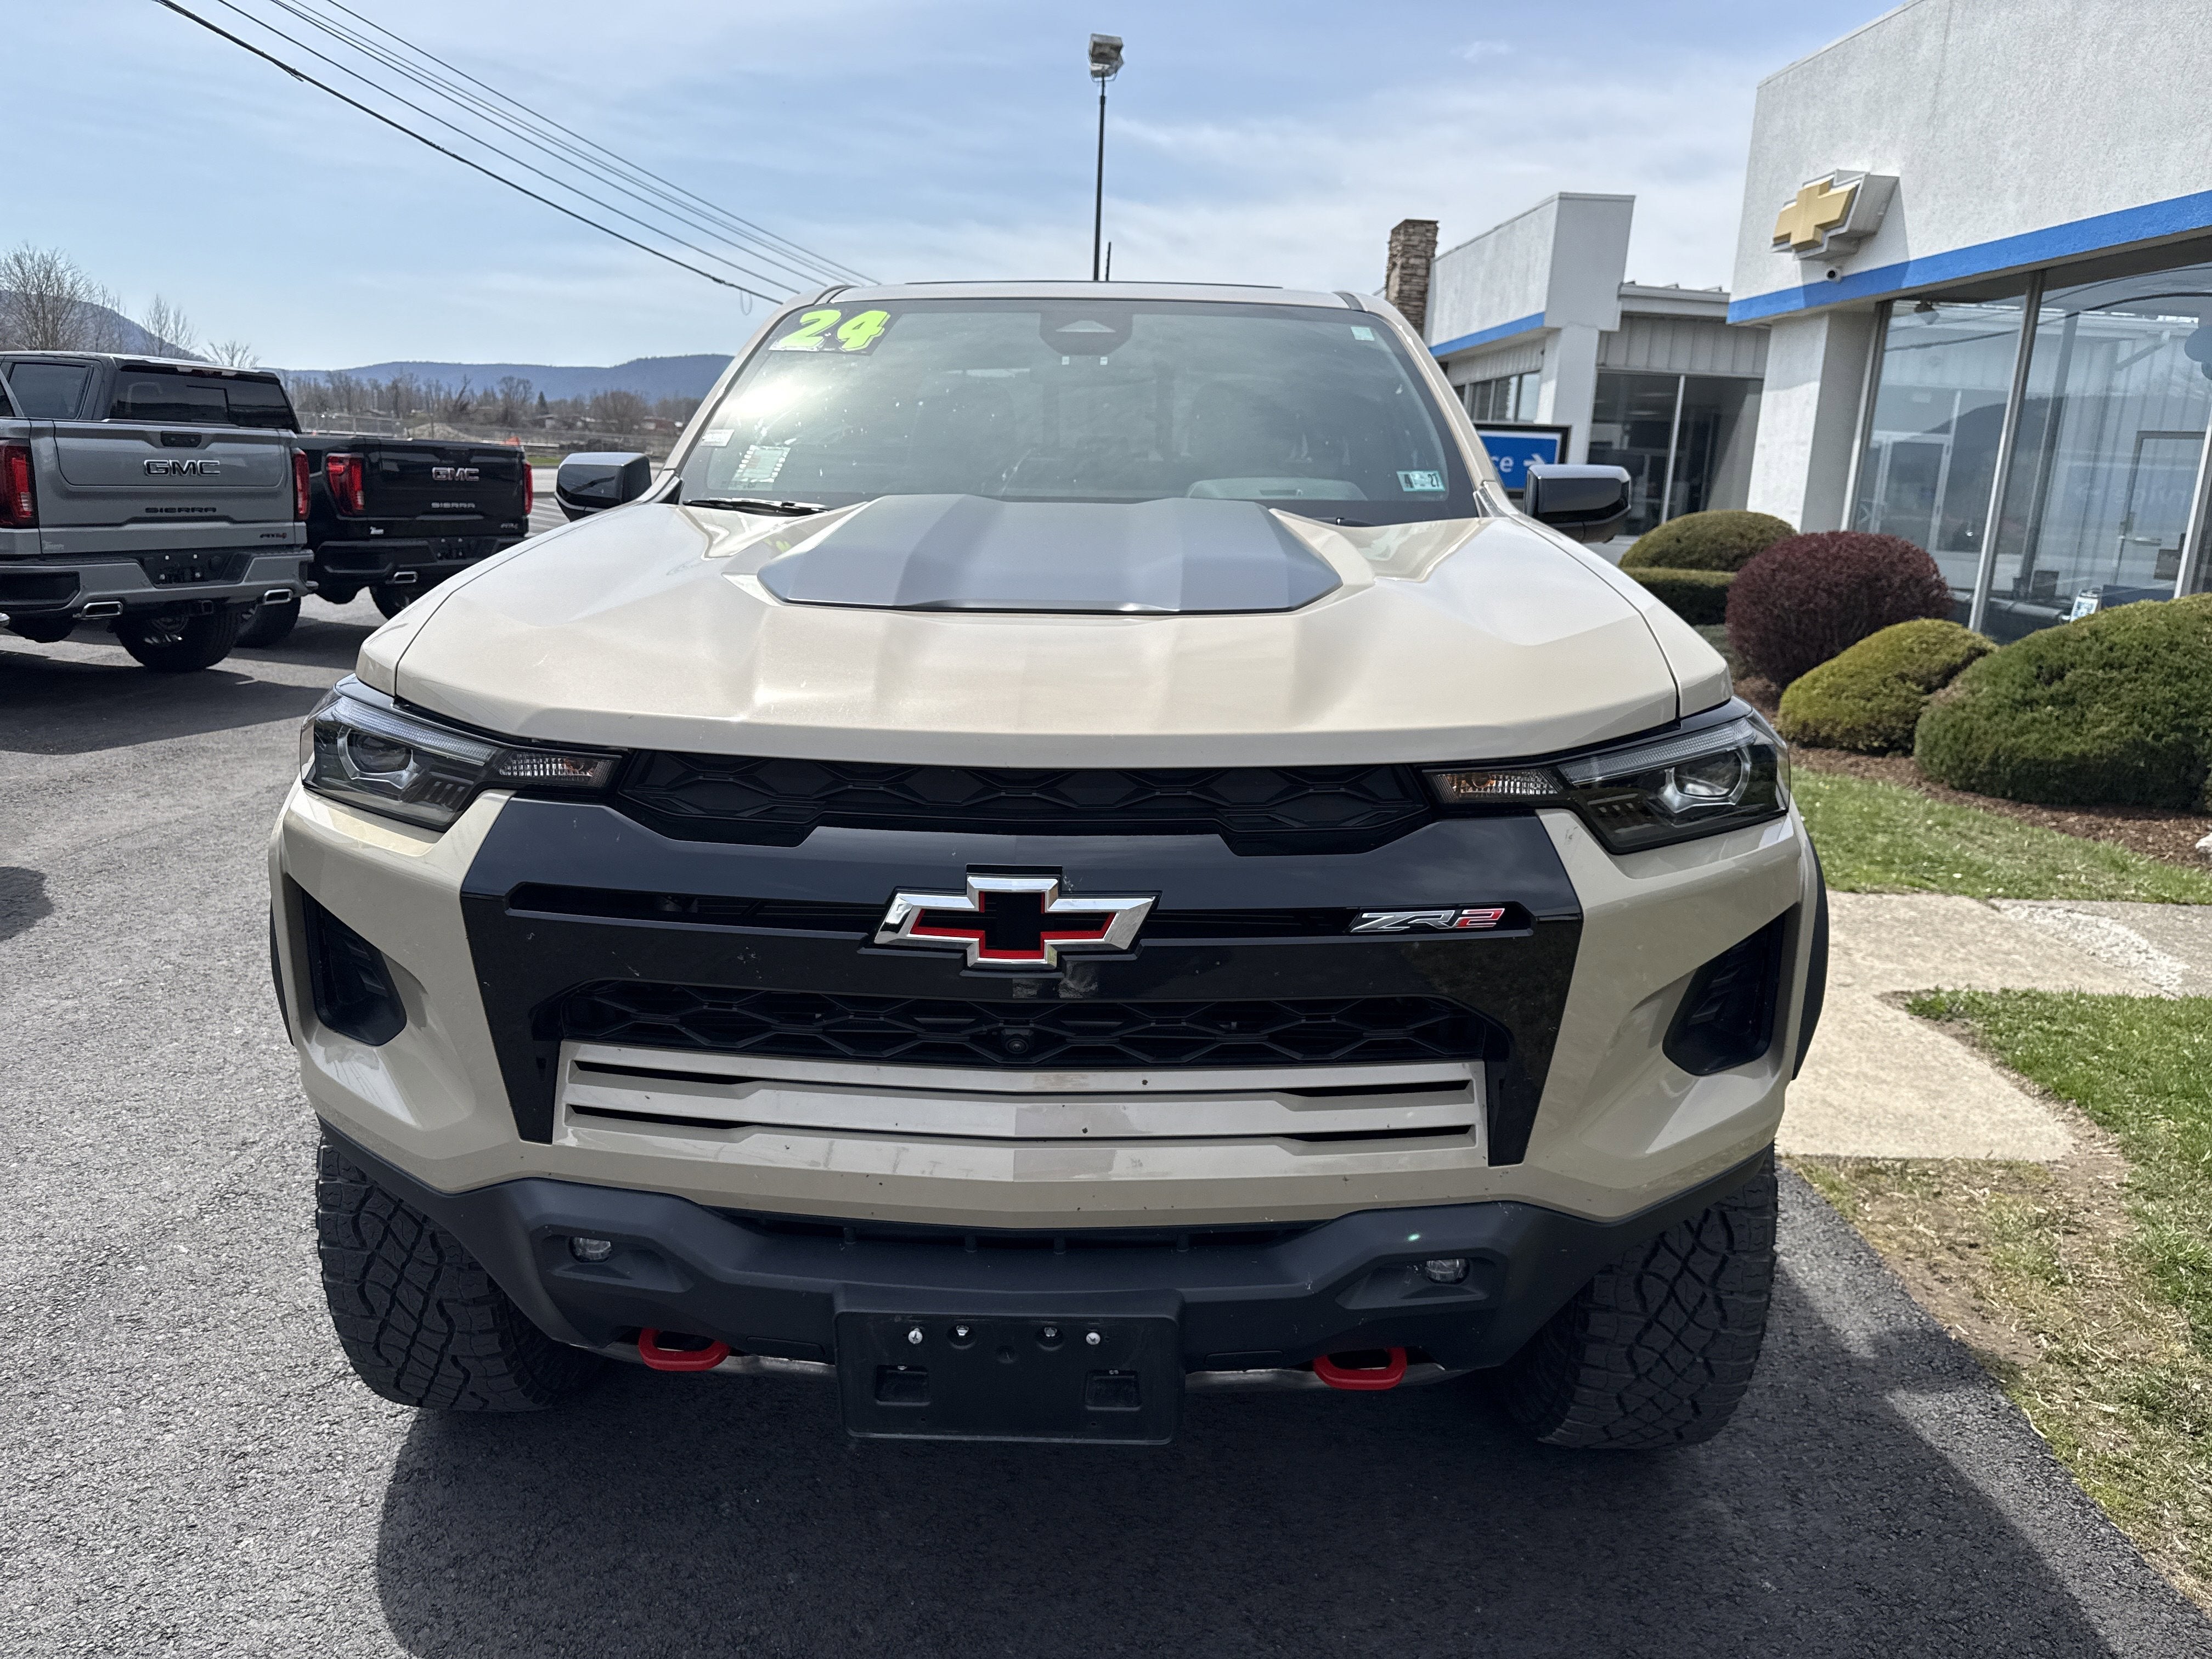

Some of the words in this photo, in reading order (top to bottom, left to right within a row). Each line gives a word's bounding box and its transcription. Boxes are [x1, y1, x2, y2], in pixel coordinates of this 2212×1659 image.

[771, 309, 891, 352] 24
[144, 459, 221, 476] GMC
[432, 467, 479, 482] GMC
[1427, 473, 1440, 487] 27
[1350, 908, 1505, 933] ZR2
